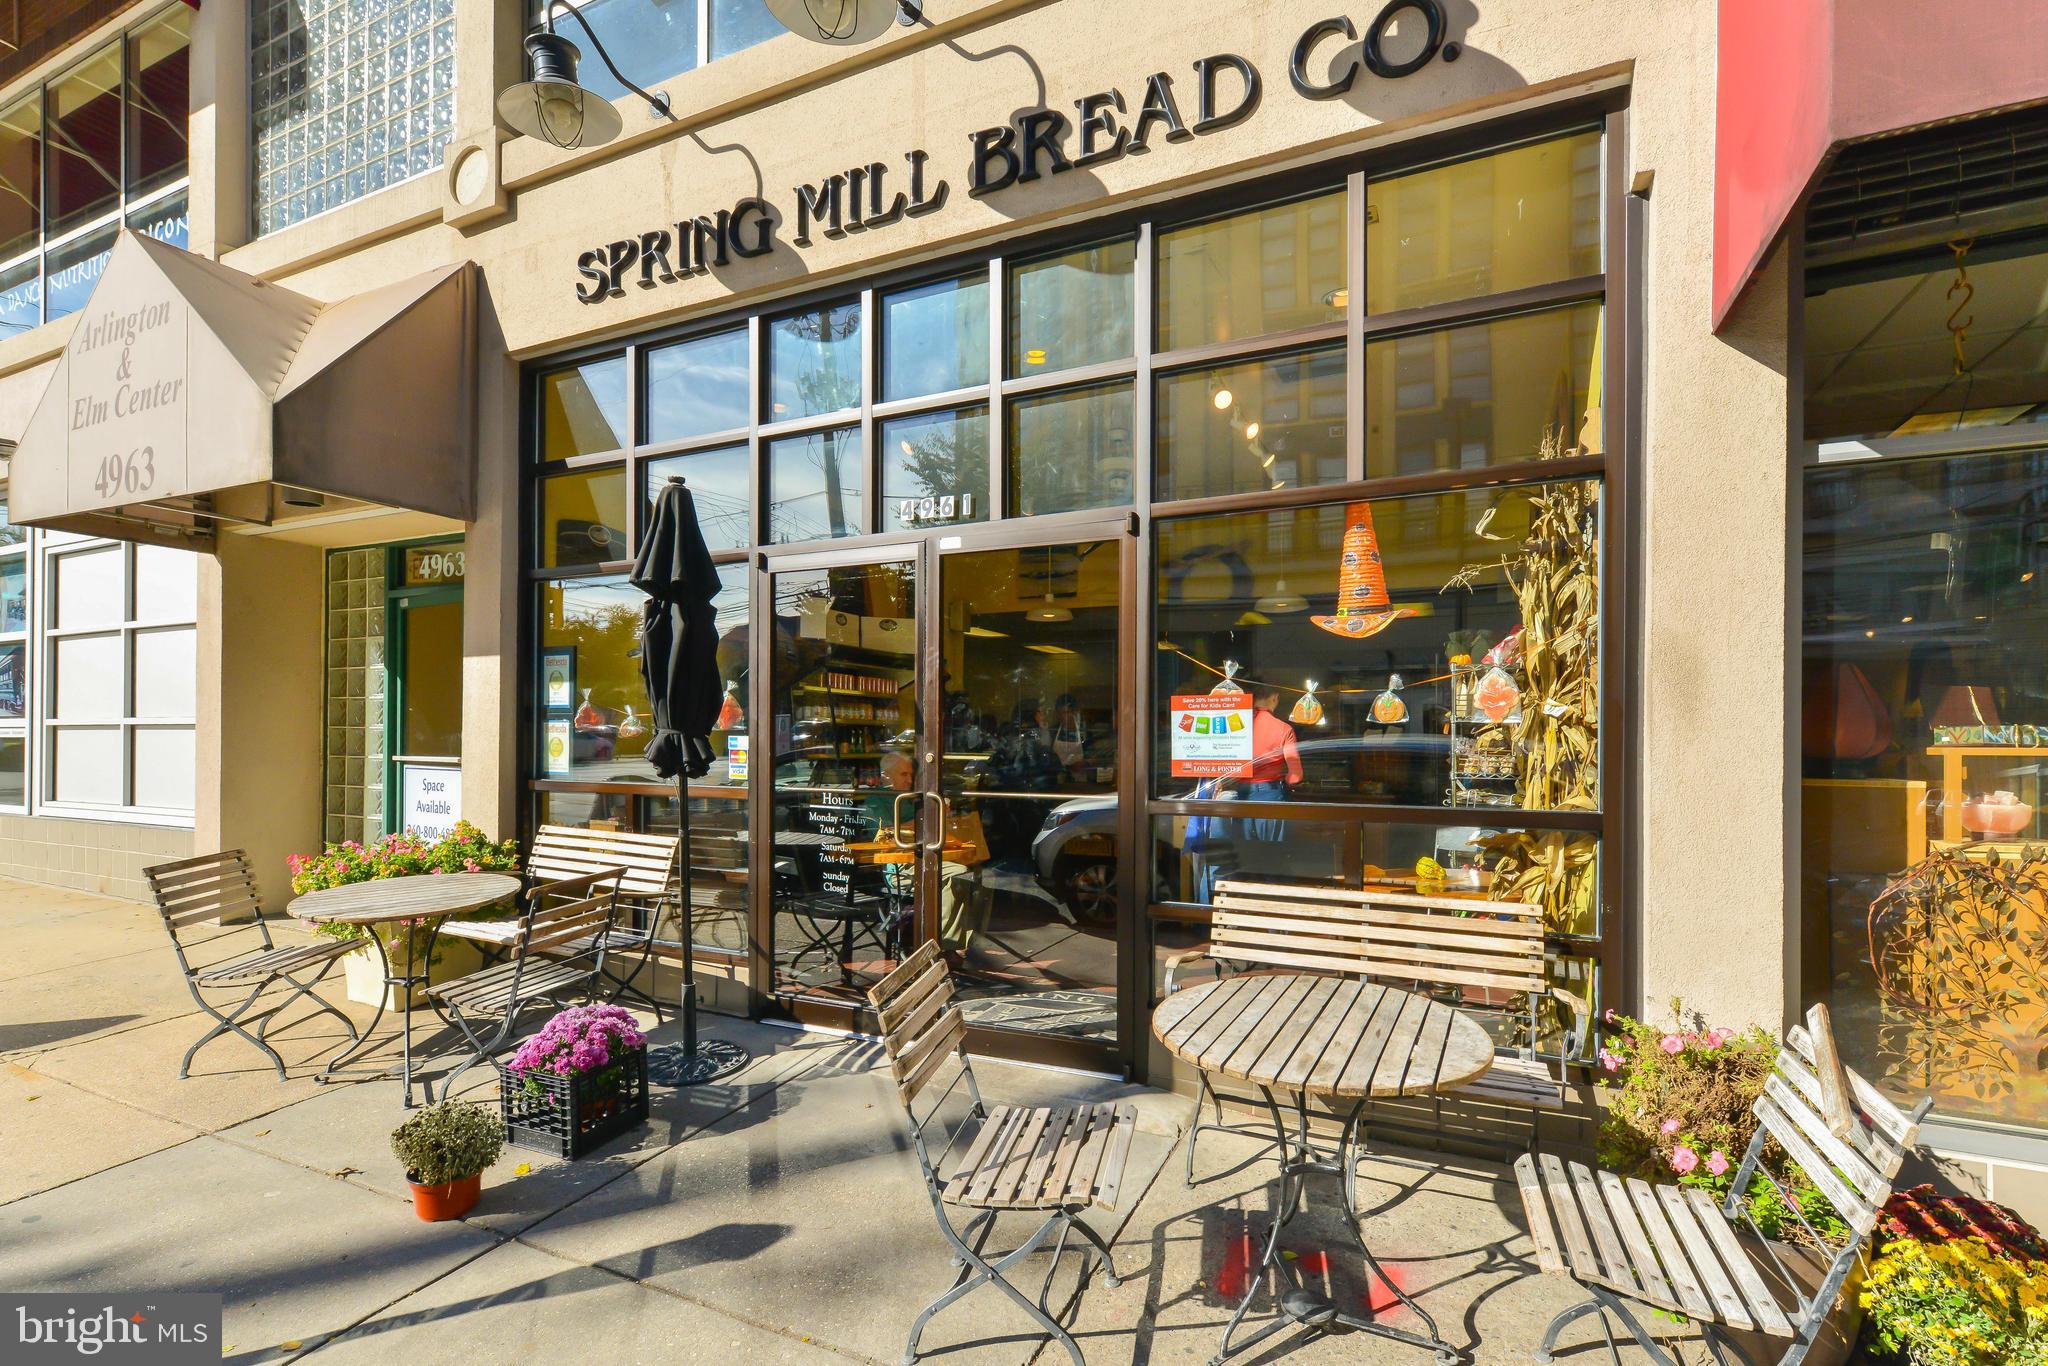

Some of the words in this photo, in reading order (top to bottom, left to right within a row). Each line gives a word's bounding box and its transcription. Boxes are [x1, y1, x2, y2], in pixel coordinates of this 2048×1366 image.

[576, 199, 775, 306] SPRING
[793, 149, 950, 249] MILL
[967, 53, 1263, 200] BREAD
[1288, 0, 1462, 101] CO.
[7, 282, 41, 311] DANC
[77, 300, 170, 354] Arlington
[116, 347, 132, 382] &
[71, 395, 108, 431] Elm
[114, 378, 183, 419] Center
[94, 446, 155, 499] 4963
[902, 494, 970, 519] 4961
[419, 551, 465, 579] 4963
[422, 778, 445, 795] Space
[416, 800, 451, 815] Available
[822, 792, 854, 806] Hours
[808, 811, 839, 825] Monday
[844, 814, 867, 826] Friday
[819, 825, 835, 834] 7AM
[840, 826, 855, 836] 7PM
[821, 841, 852, 854] Saturday
[819, 853, 835, 863] 7AM
[839, 855, 855, 865] 6PM
[822, 871, 850, 883] Sunday
[823, 882, 849, 894] Closed
